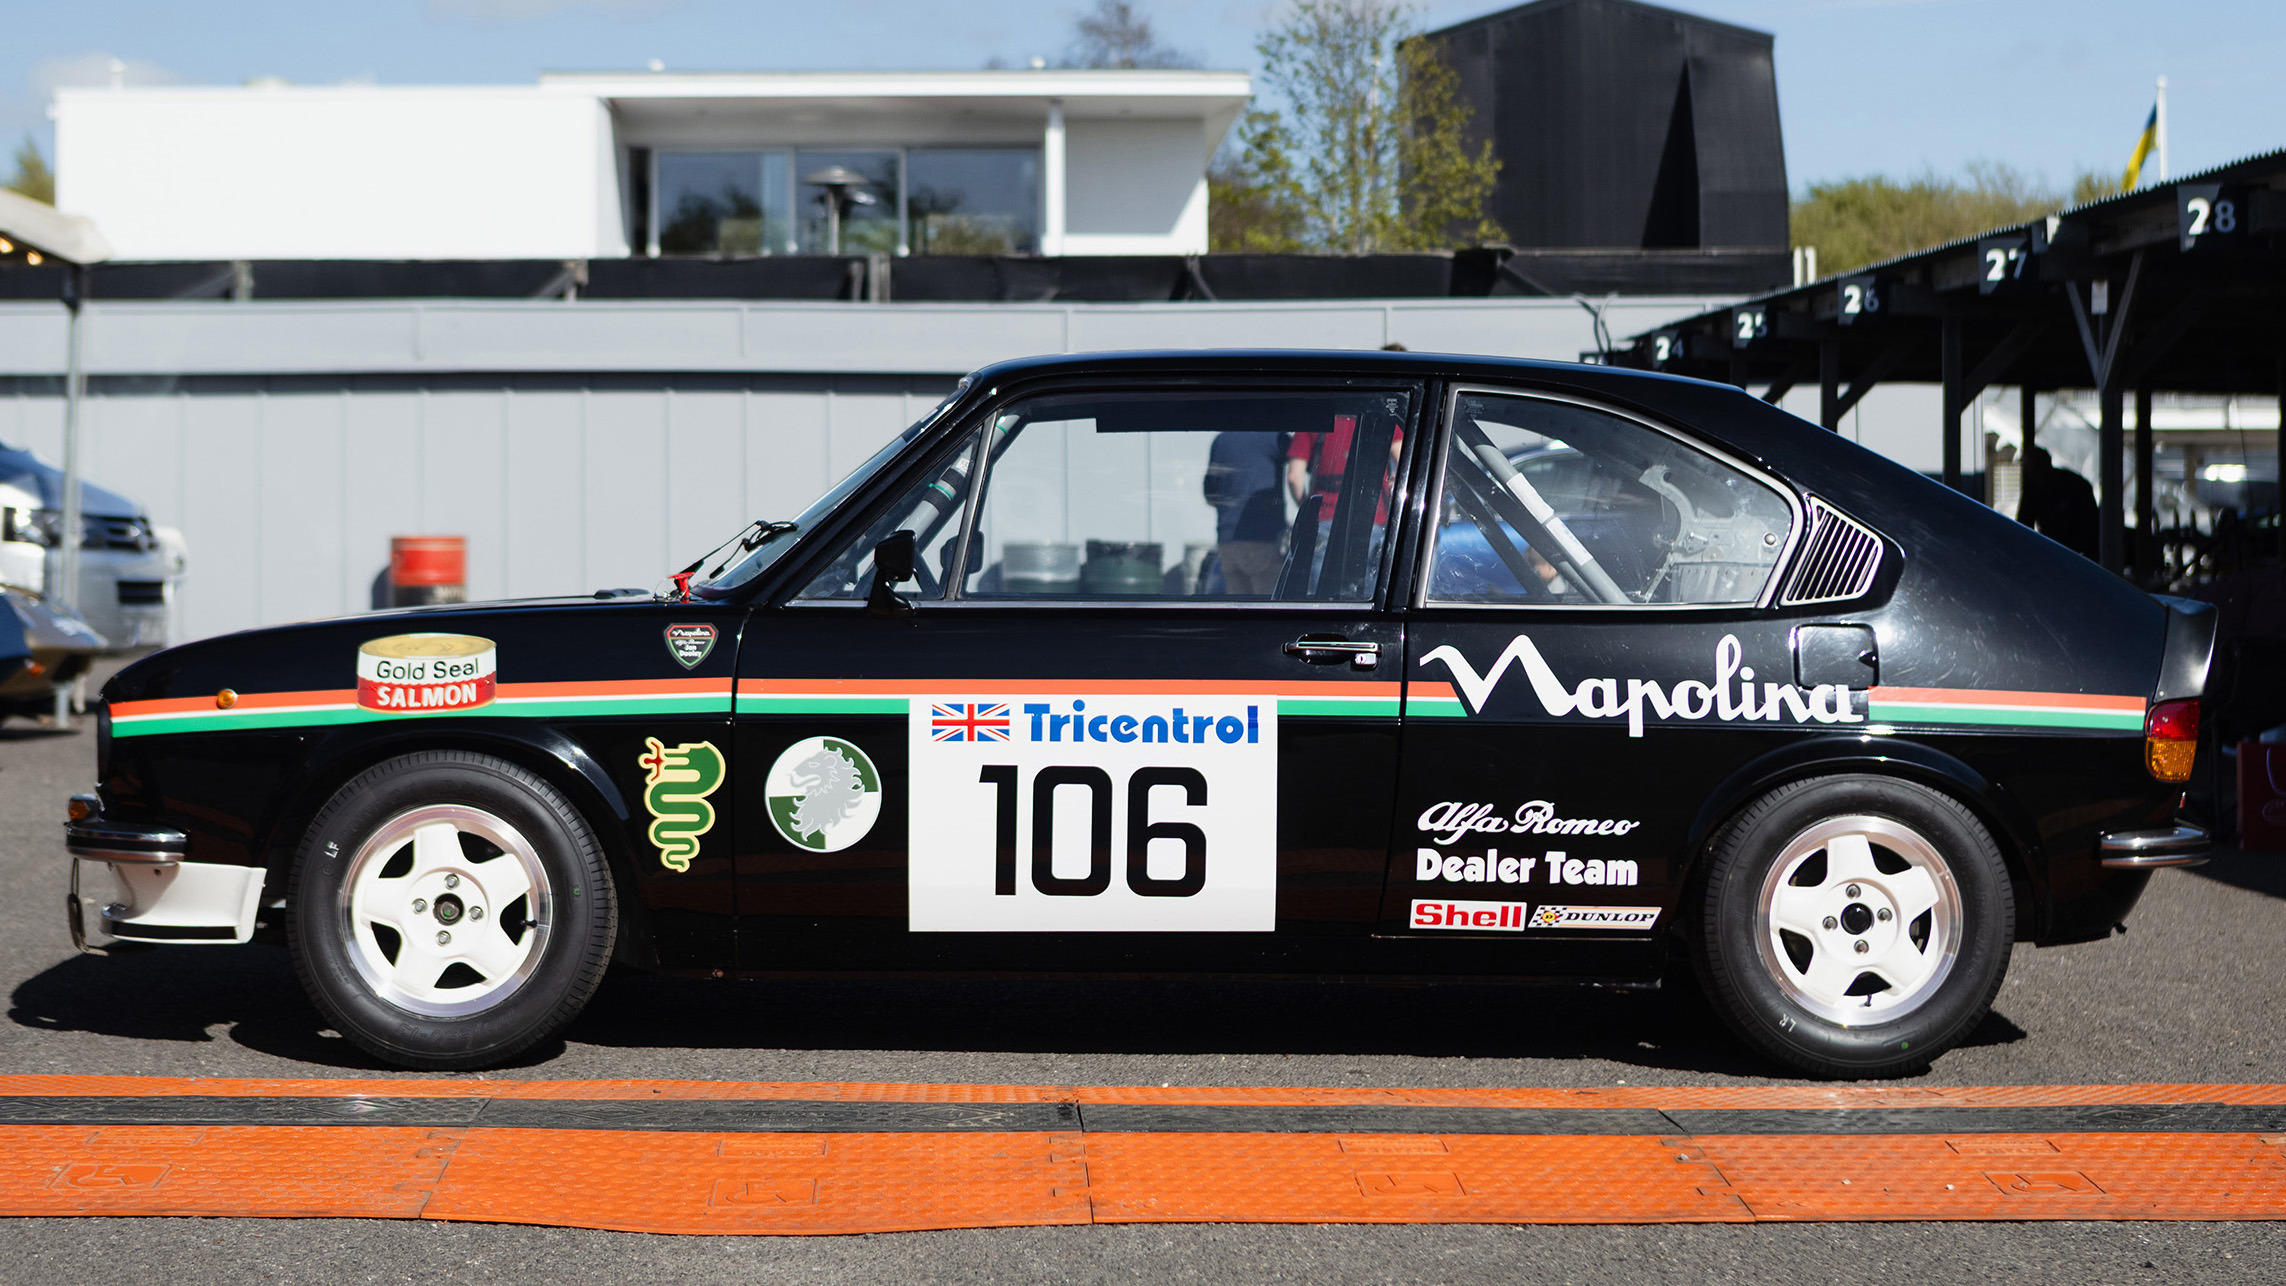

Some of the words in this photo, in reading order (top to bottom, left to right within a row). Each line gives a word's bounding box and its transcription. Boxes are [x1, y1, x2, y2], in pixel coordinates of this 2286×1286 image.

[2185, 198, 2236, 236] 28
[1985, 247, 2027, 282] 27
[1843, 285, 1880, 314] 26
[1737, 312, 1767, 339] 25
[1654, 336, 1684, 361] 24
[376, 660, 426, 680] Gold
[433, 658, 479, 679] Seal
[376, 683, 477, 708] SALMON
[1419, 633, 1863, 738] Napolina
[1024, 700, 1259, 744] Tricentrol
[978, 764, 1208, 897] 106
[1417, 801, 1508, 845] Alfa
[1510, 800, 1640, 836] Romeo
[325, 840, 340, 859] LF
[1416, 848, 1537, 883] Dealer
[1544, 851, 1639, 886] Team
[1414, 903, 1522, 928] Shell
[1564, 912, 1655, 922] DUNLOP
[1779, 1012, 1798, 1033] LR
